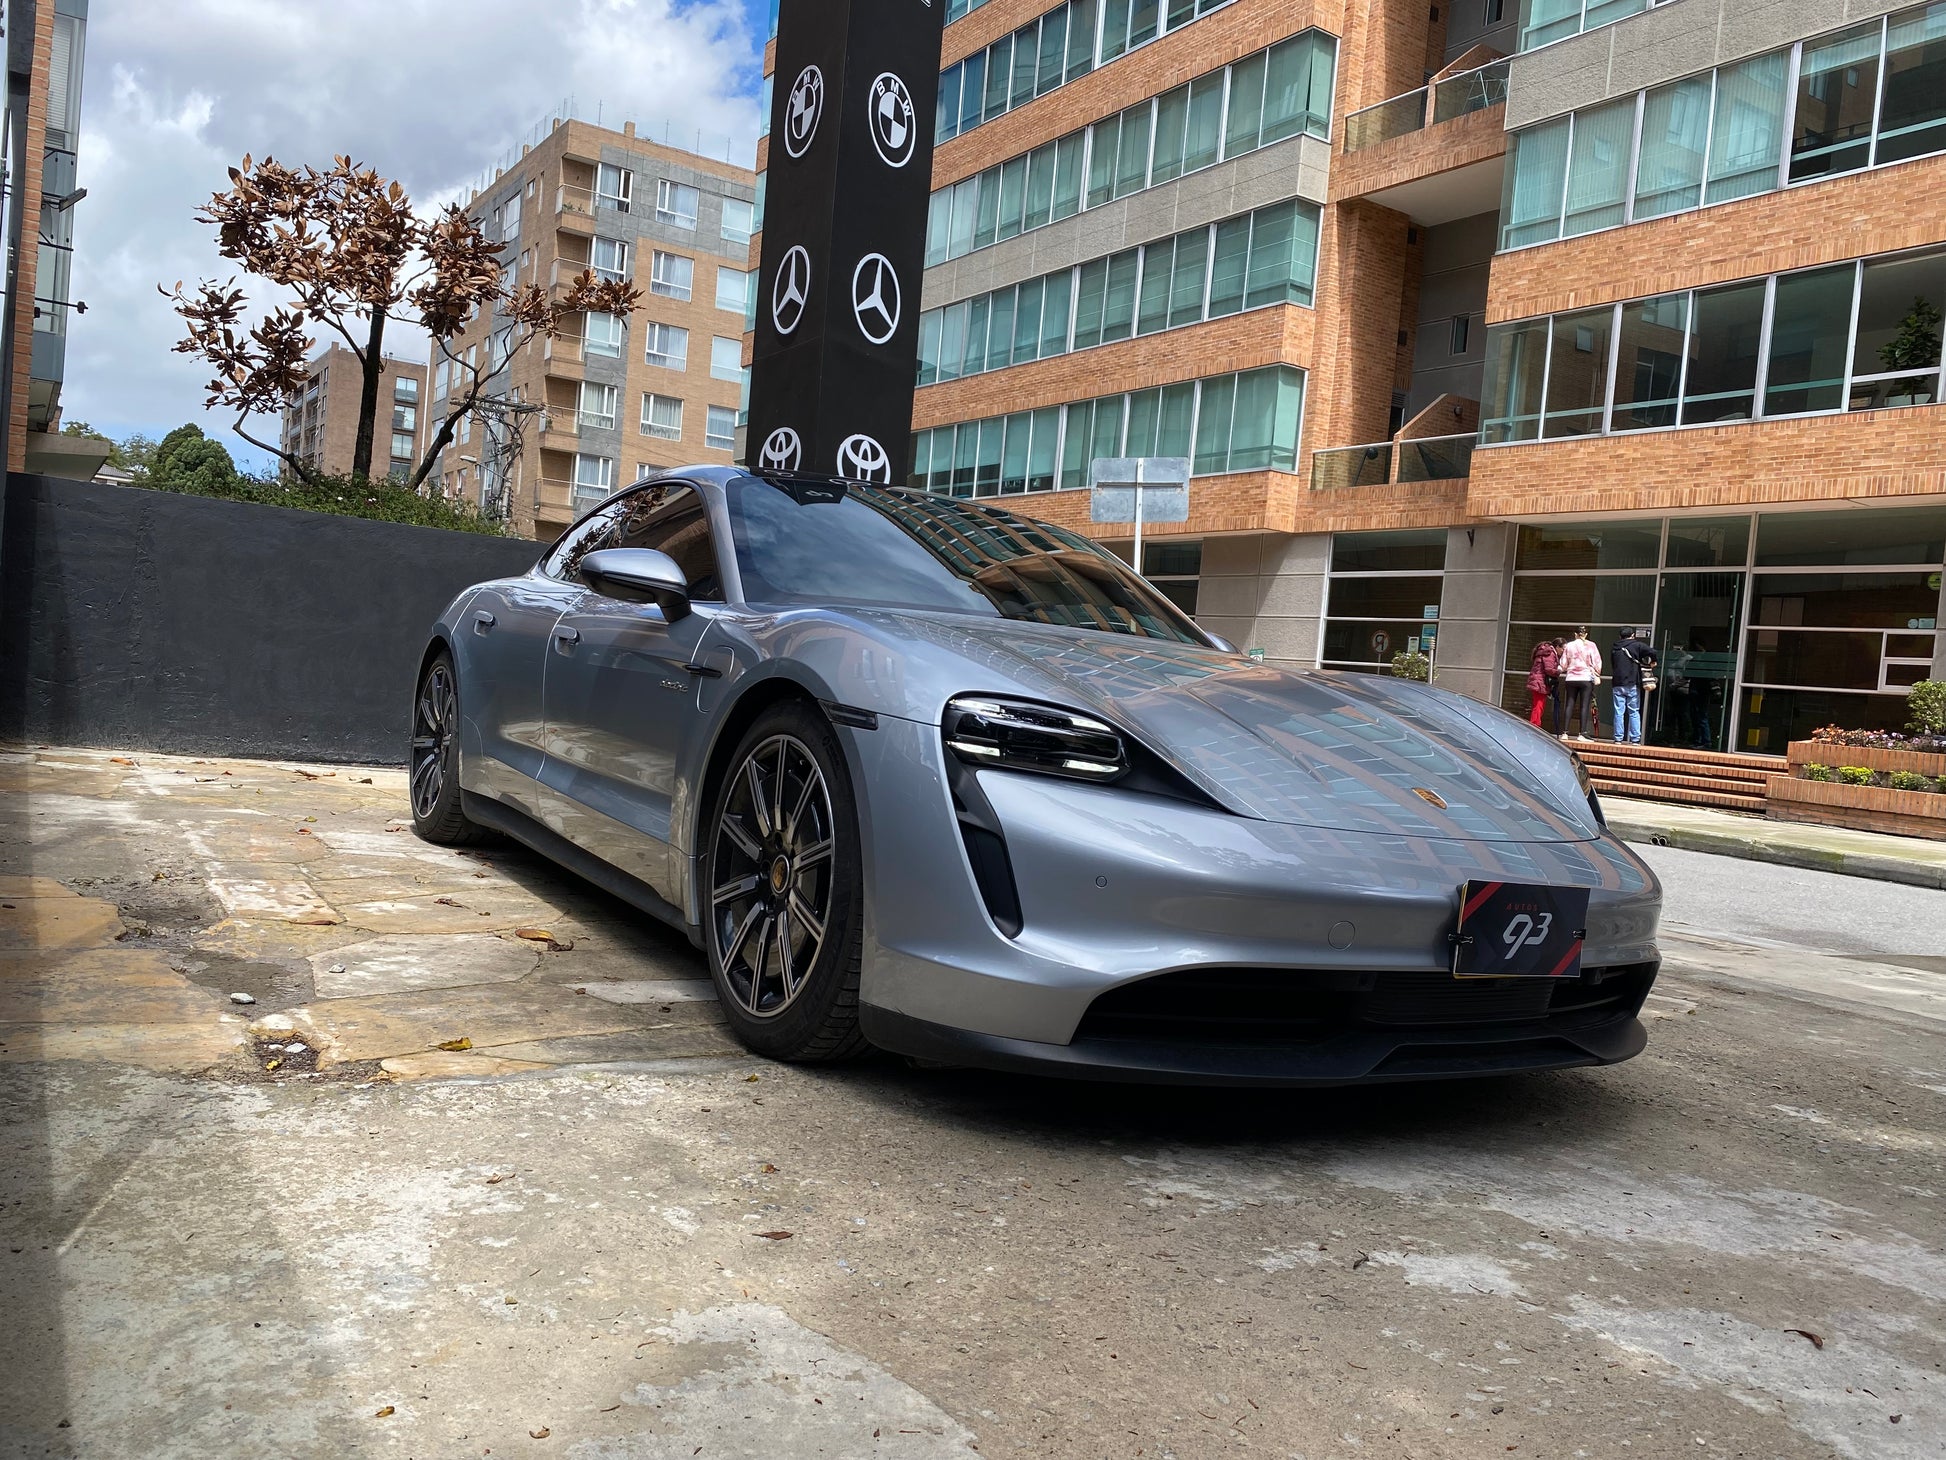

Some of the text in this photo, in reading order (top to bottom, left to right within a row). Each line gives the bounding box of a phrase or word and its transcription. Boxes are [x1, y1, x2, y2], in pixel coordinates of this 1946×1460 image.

[792, 70, 820, 104] BMW
[876, 78, 912, 117] BMW
[1506, 903, 1538, 912] AUTOS
